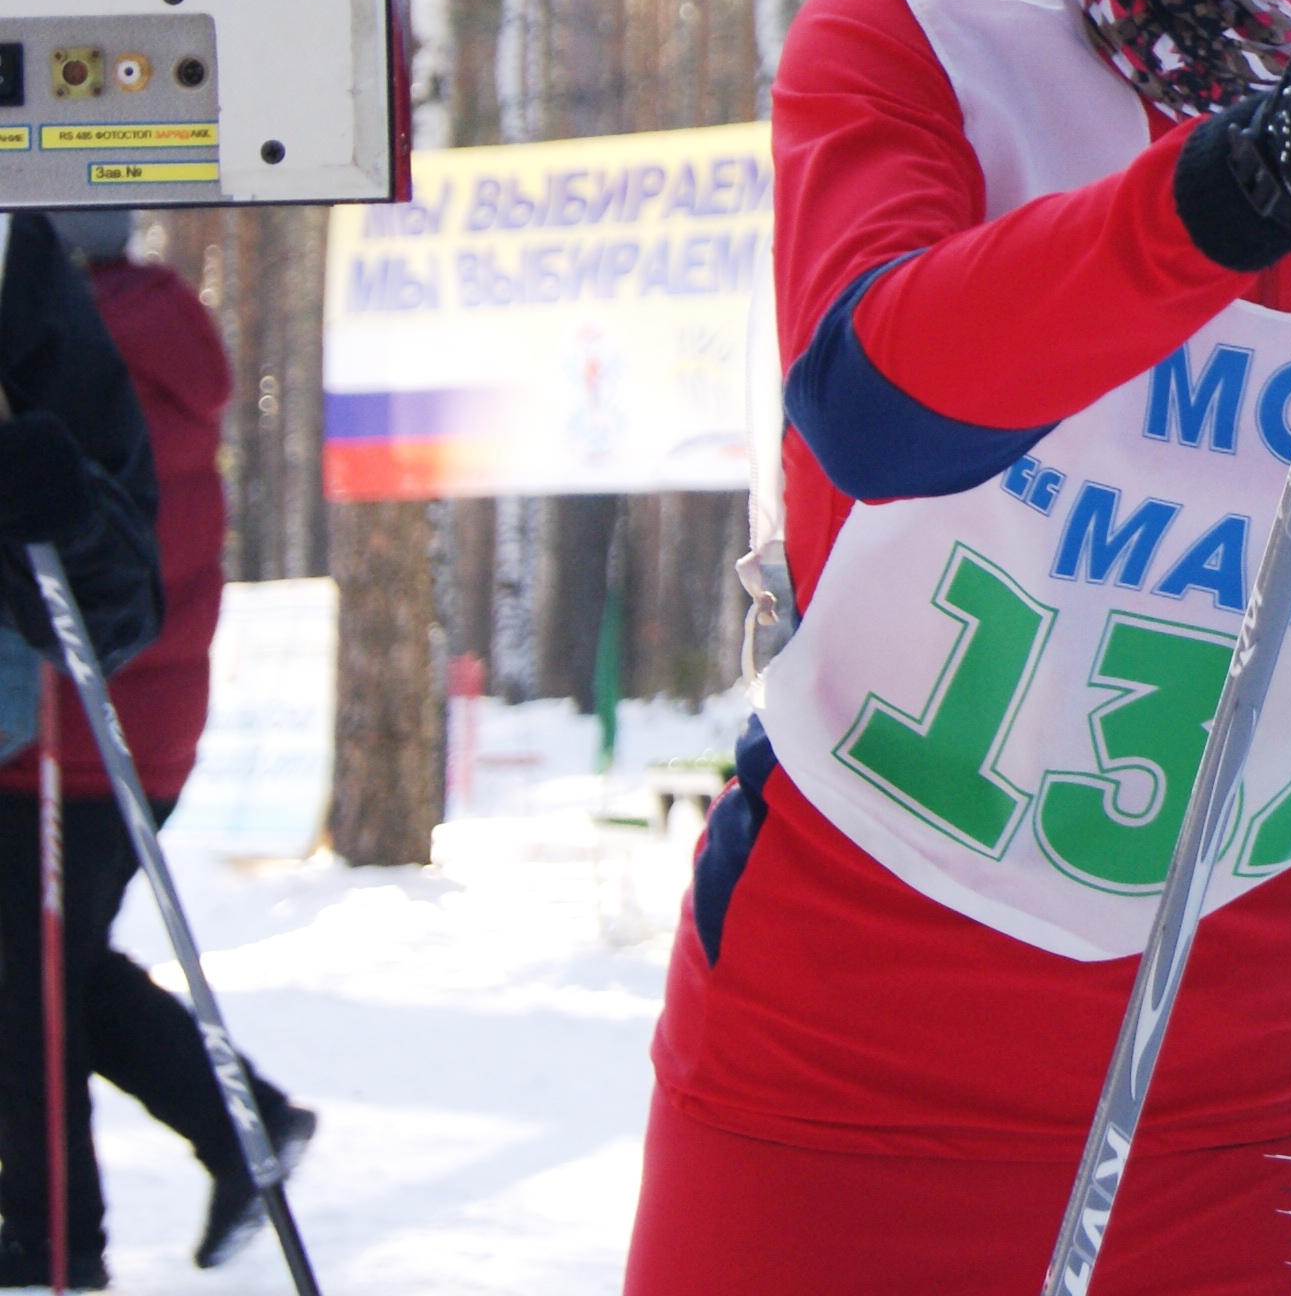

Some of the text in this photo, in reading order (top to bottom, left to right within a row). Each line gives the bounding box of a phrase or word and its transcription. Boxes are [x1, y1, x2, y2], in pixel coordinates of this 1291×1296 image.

[59, 131, 74, 141] RS
[464, 156, 772, 231] ВЫБИРАЕМ
[346, 233, 757, 312] МЫ ВЫБИРАЕМ
